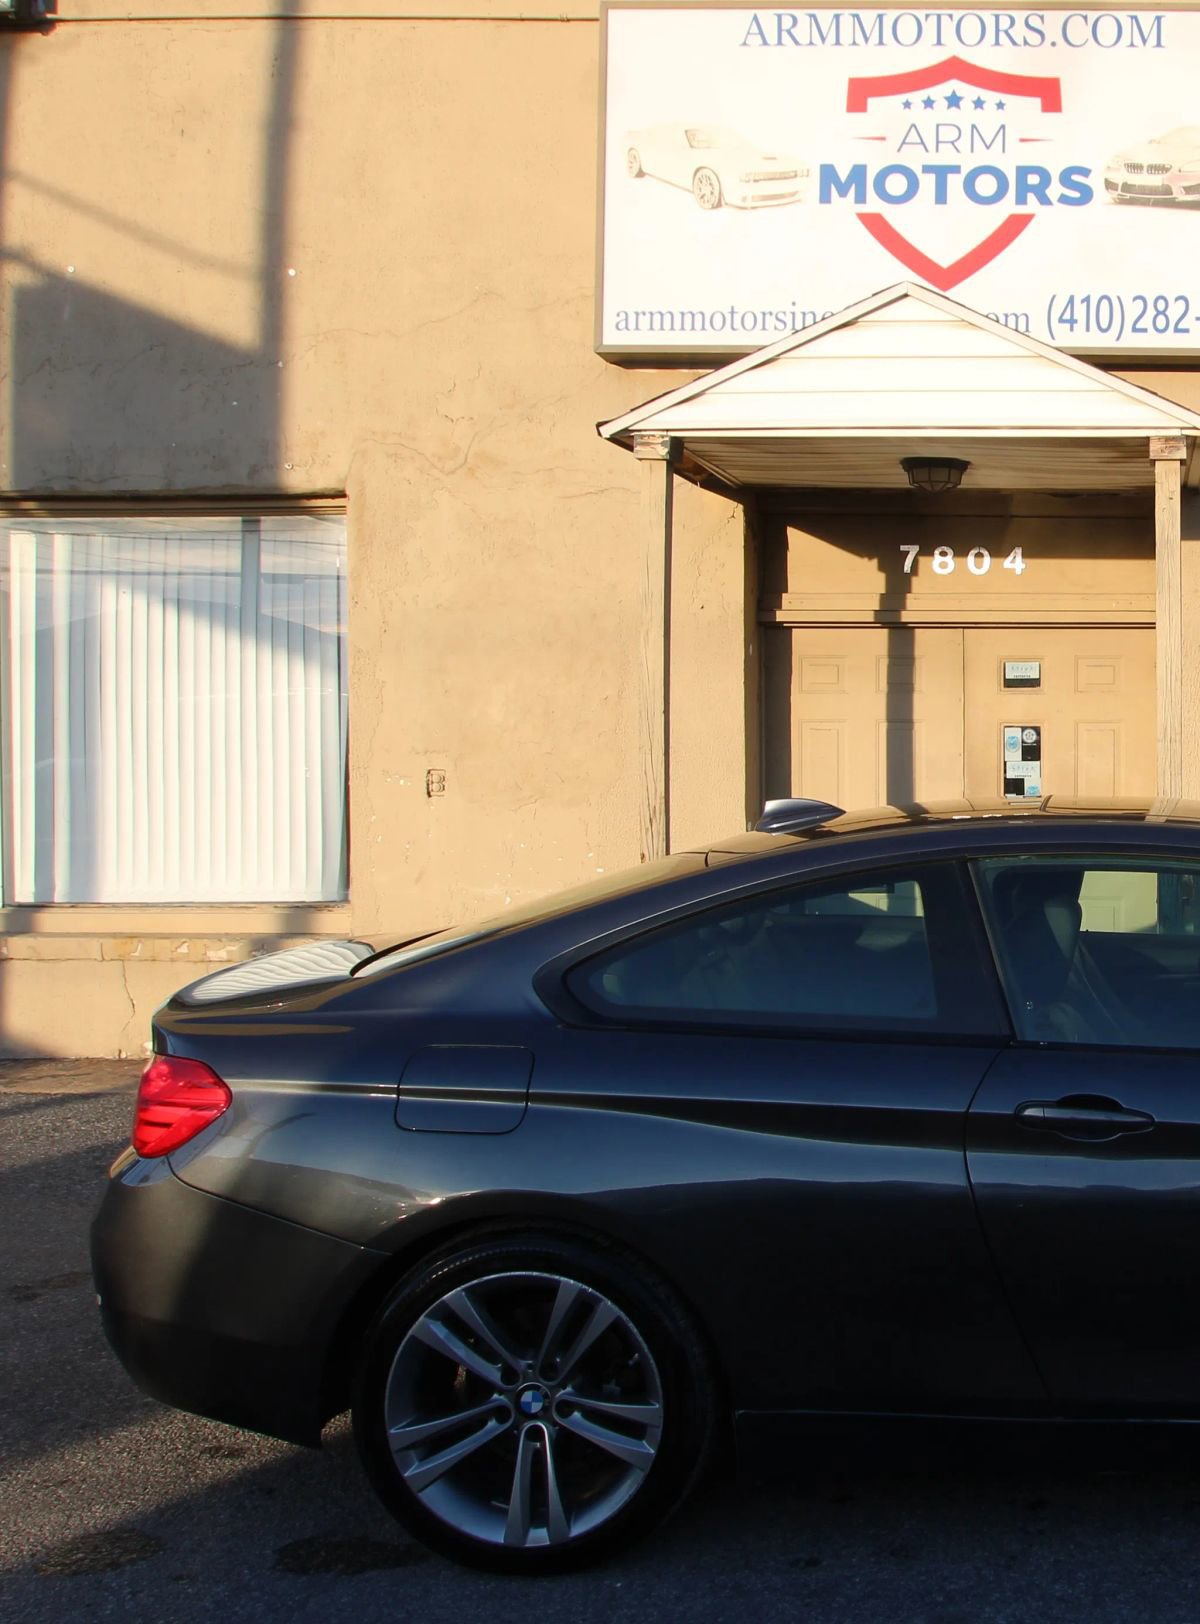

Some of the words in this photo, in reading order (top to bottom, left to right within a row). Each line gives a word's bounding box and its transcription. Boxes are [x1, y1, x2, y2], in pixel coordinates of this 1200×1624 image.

[739, 12, 1167, 49] ARMMOTORS.COM
[896, 122, 1008, 154] ARM
[818, 163, 1095, 207] MOTORS
[899, 544, 1027, 576] 7804
